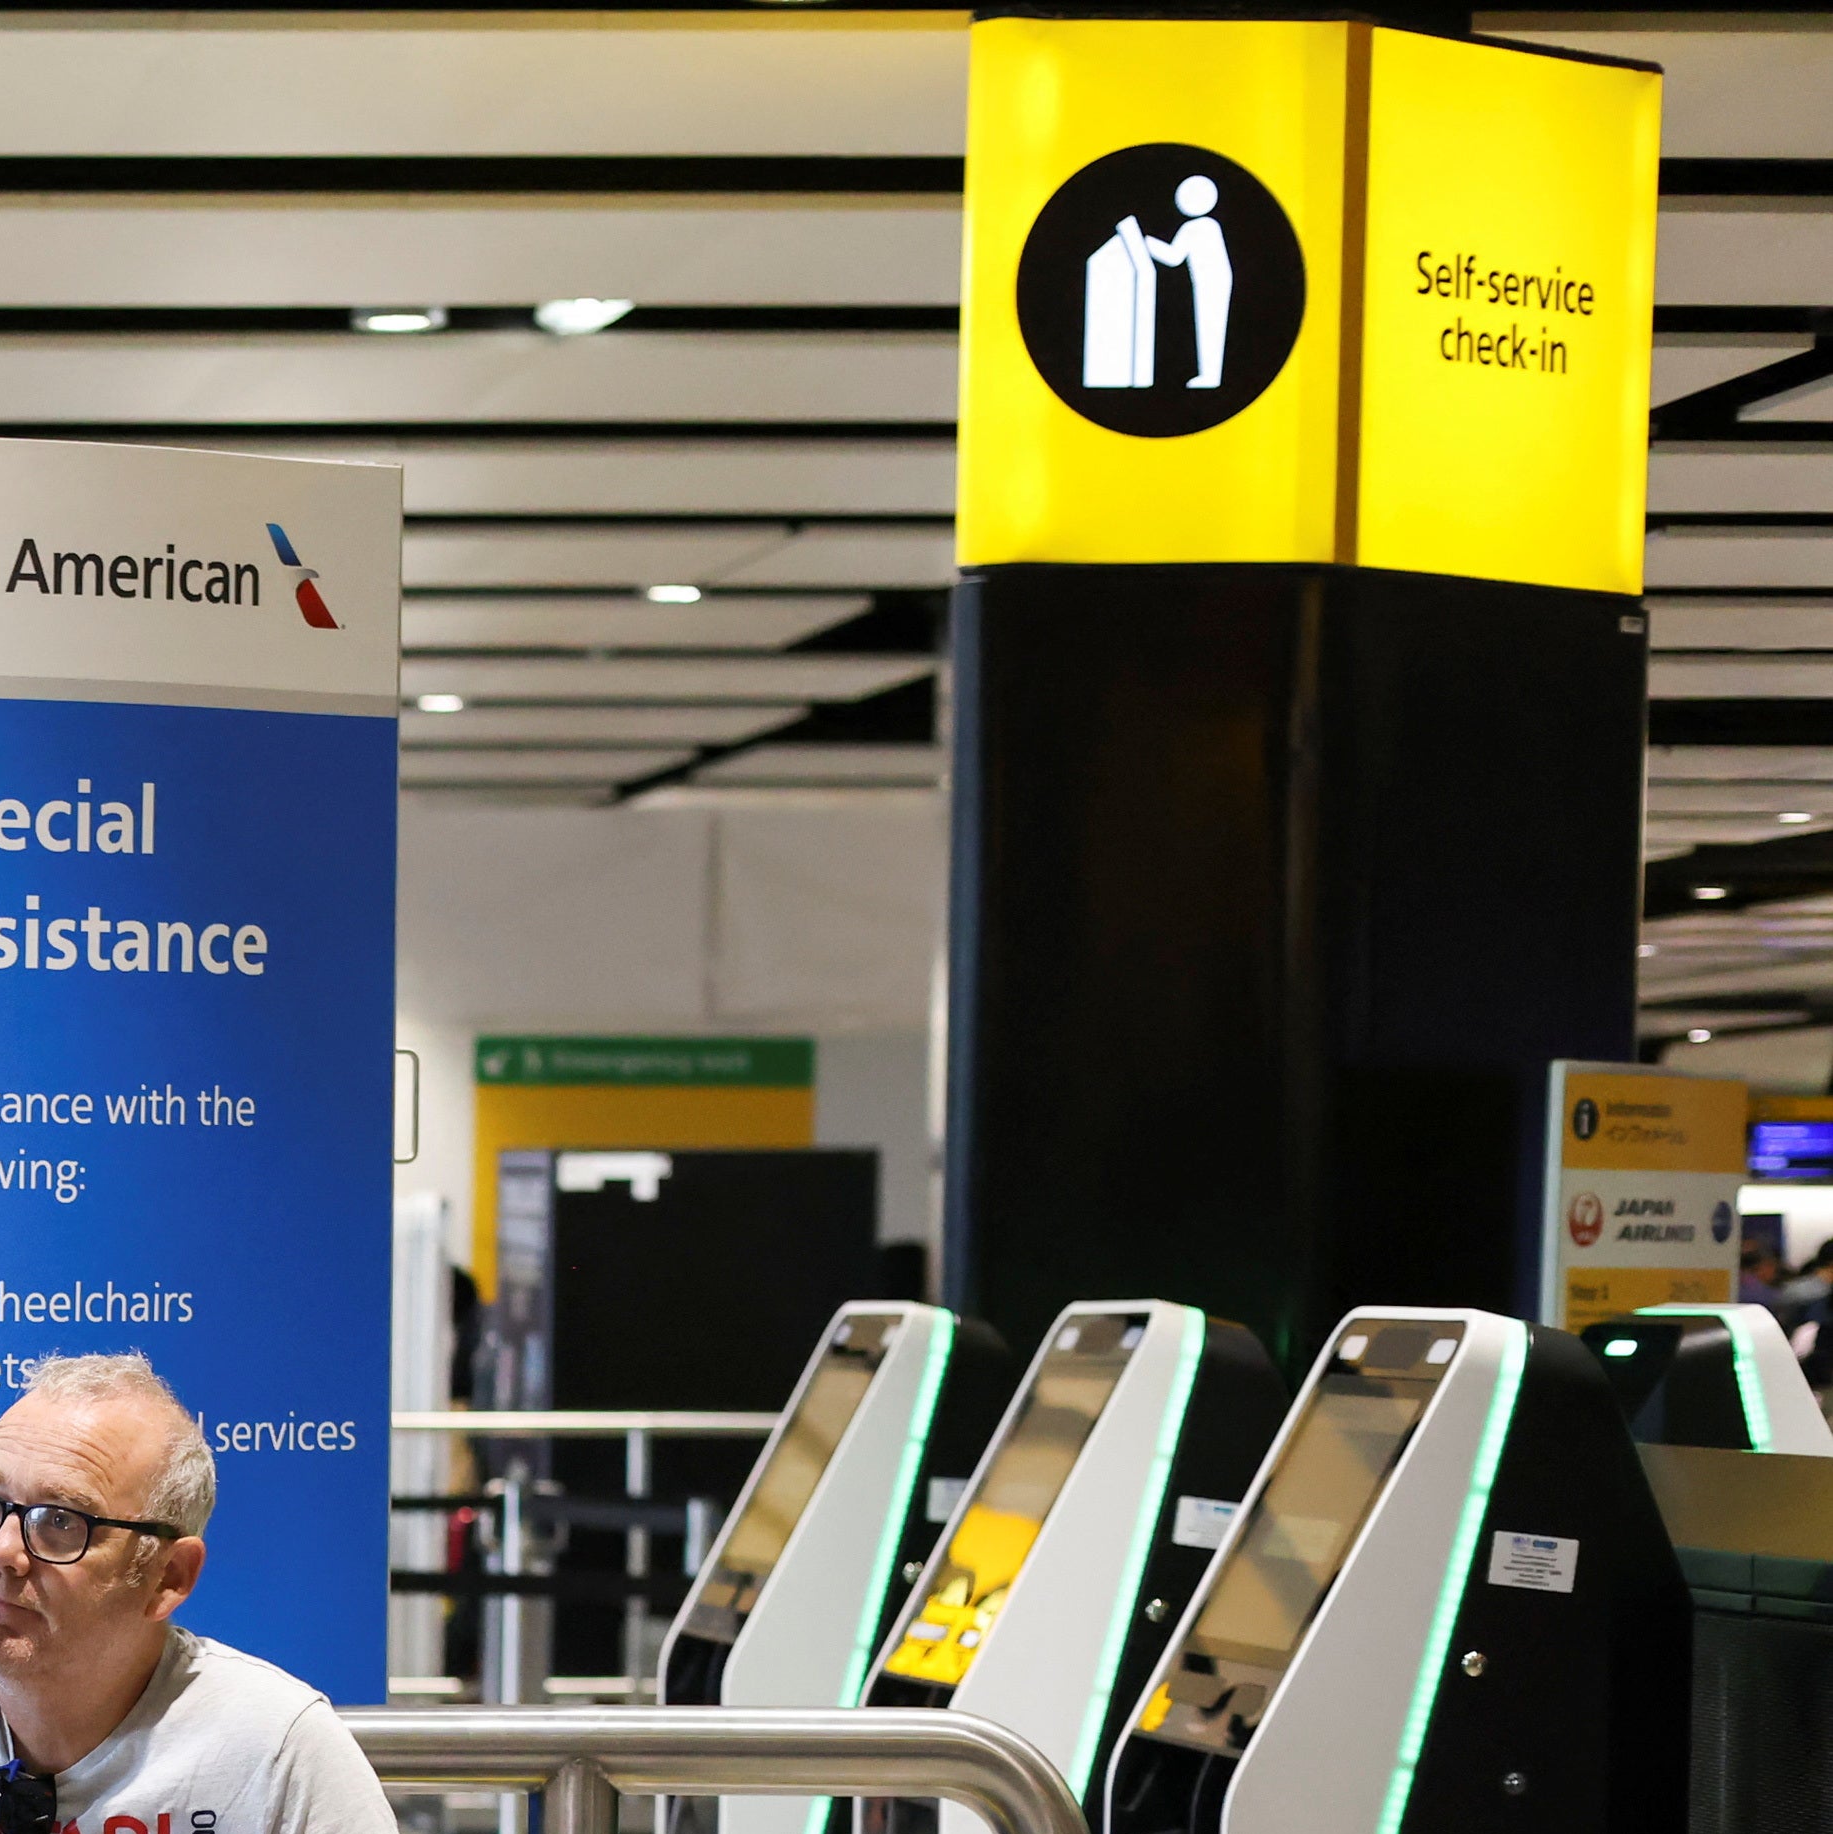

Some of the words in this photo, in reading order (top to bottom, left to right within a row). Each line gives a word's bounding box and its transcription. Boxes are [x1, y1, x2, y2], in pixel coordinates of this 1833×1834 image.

[1416, 250, 1595, 317] Self-service
[1440, 316, 1568, 375] check-in
[6, 537, 261, 607] American
[105, 1083, 187, 1126] with
[196, 1085, 256, 1128] the
[214, 1411, 356, 1453] services
